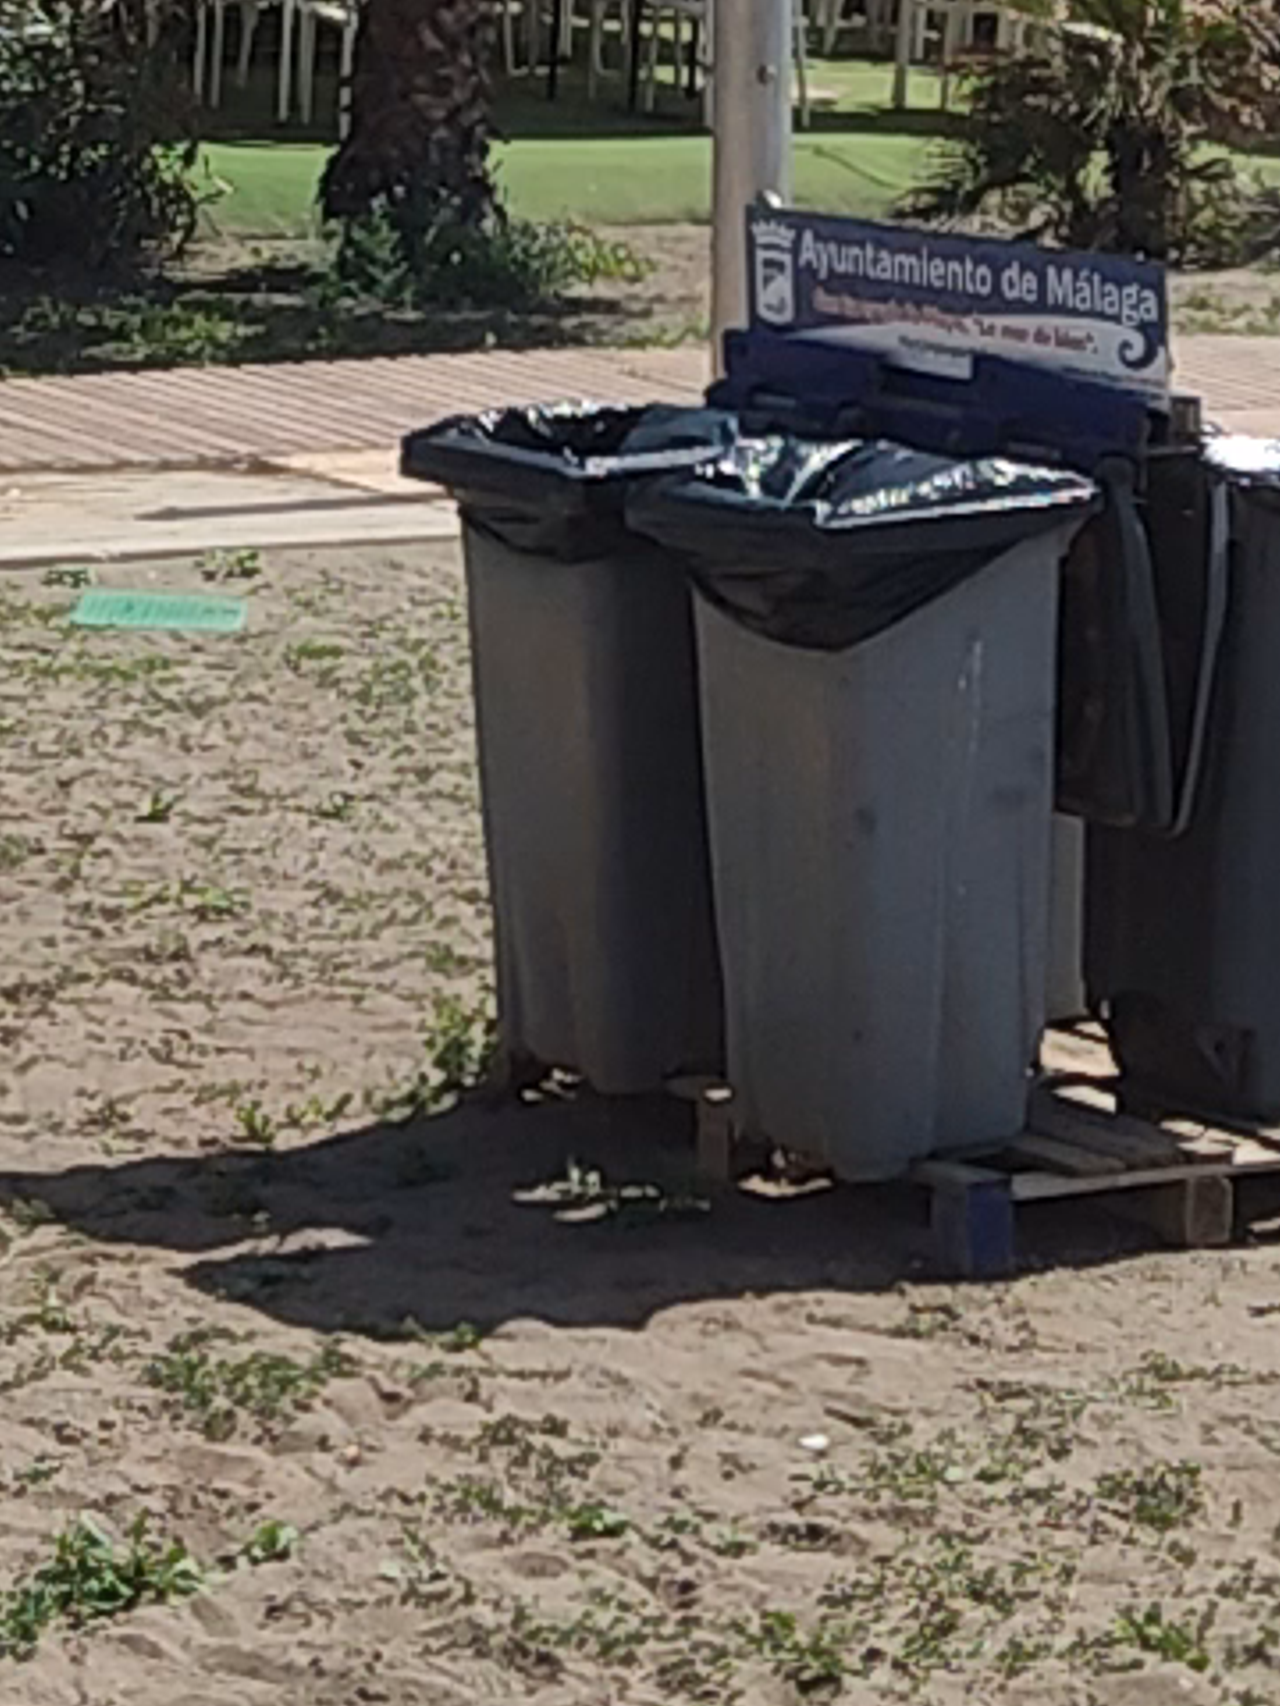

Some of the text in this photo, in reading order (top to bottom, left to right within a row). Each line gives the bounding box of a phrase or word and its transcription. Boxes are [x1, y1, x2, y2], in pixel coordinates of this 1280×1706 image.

[798, 228, 993, 296] Ayuntamiento
[1000, 260, 1038, 304] de
[1046, 263, 1160, 327] Málaga
